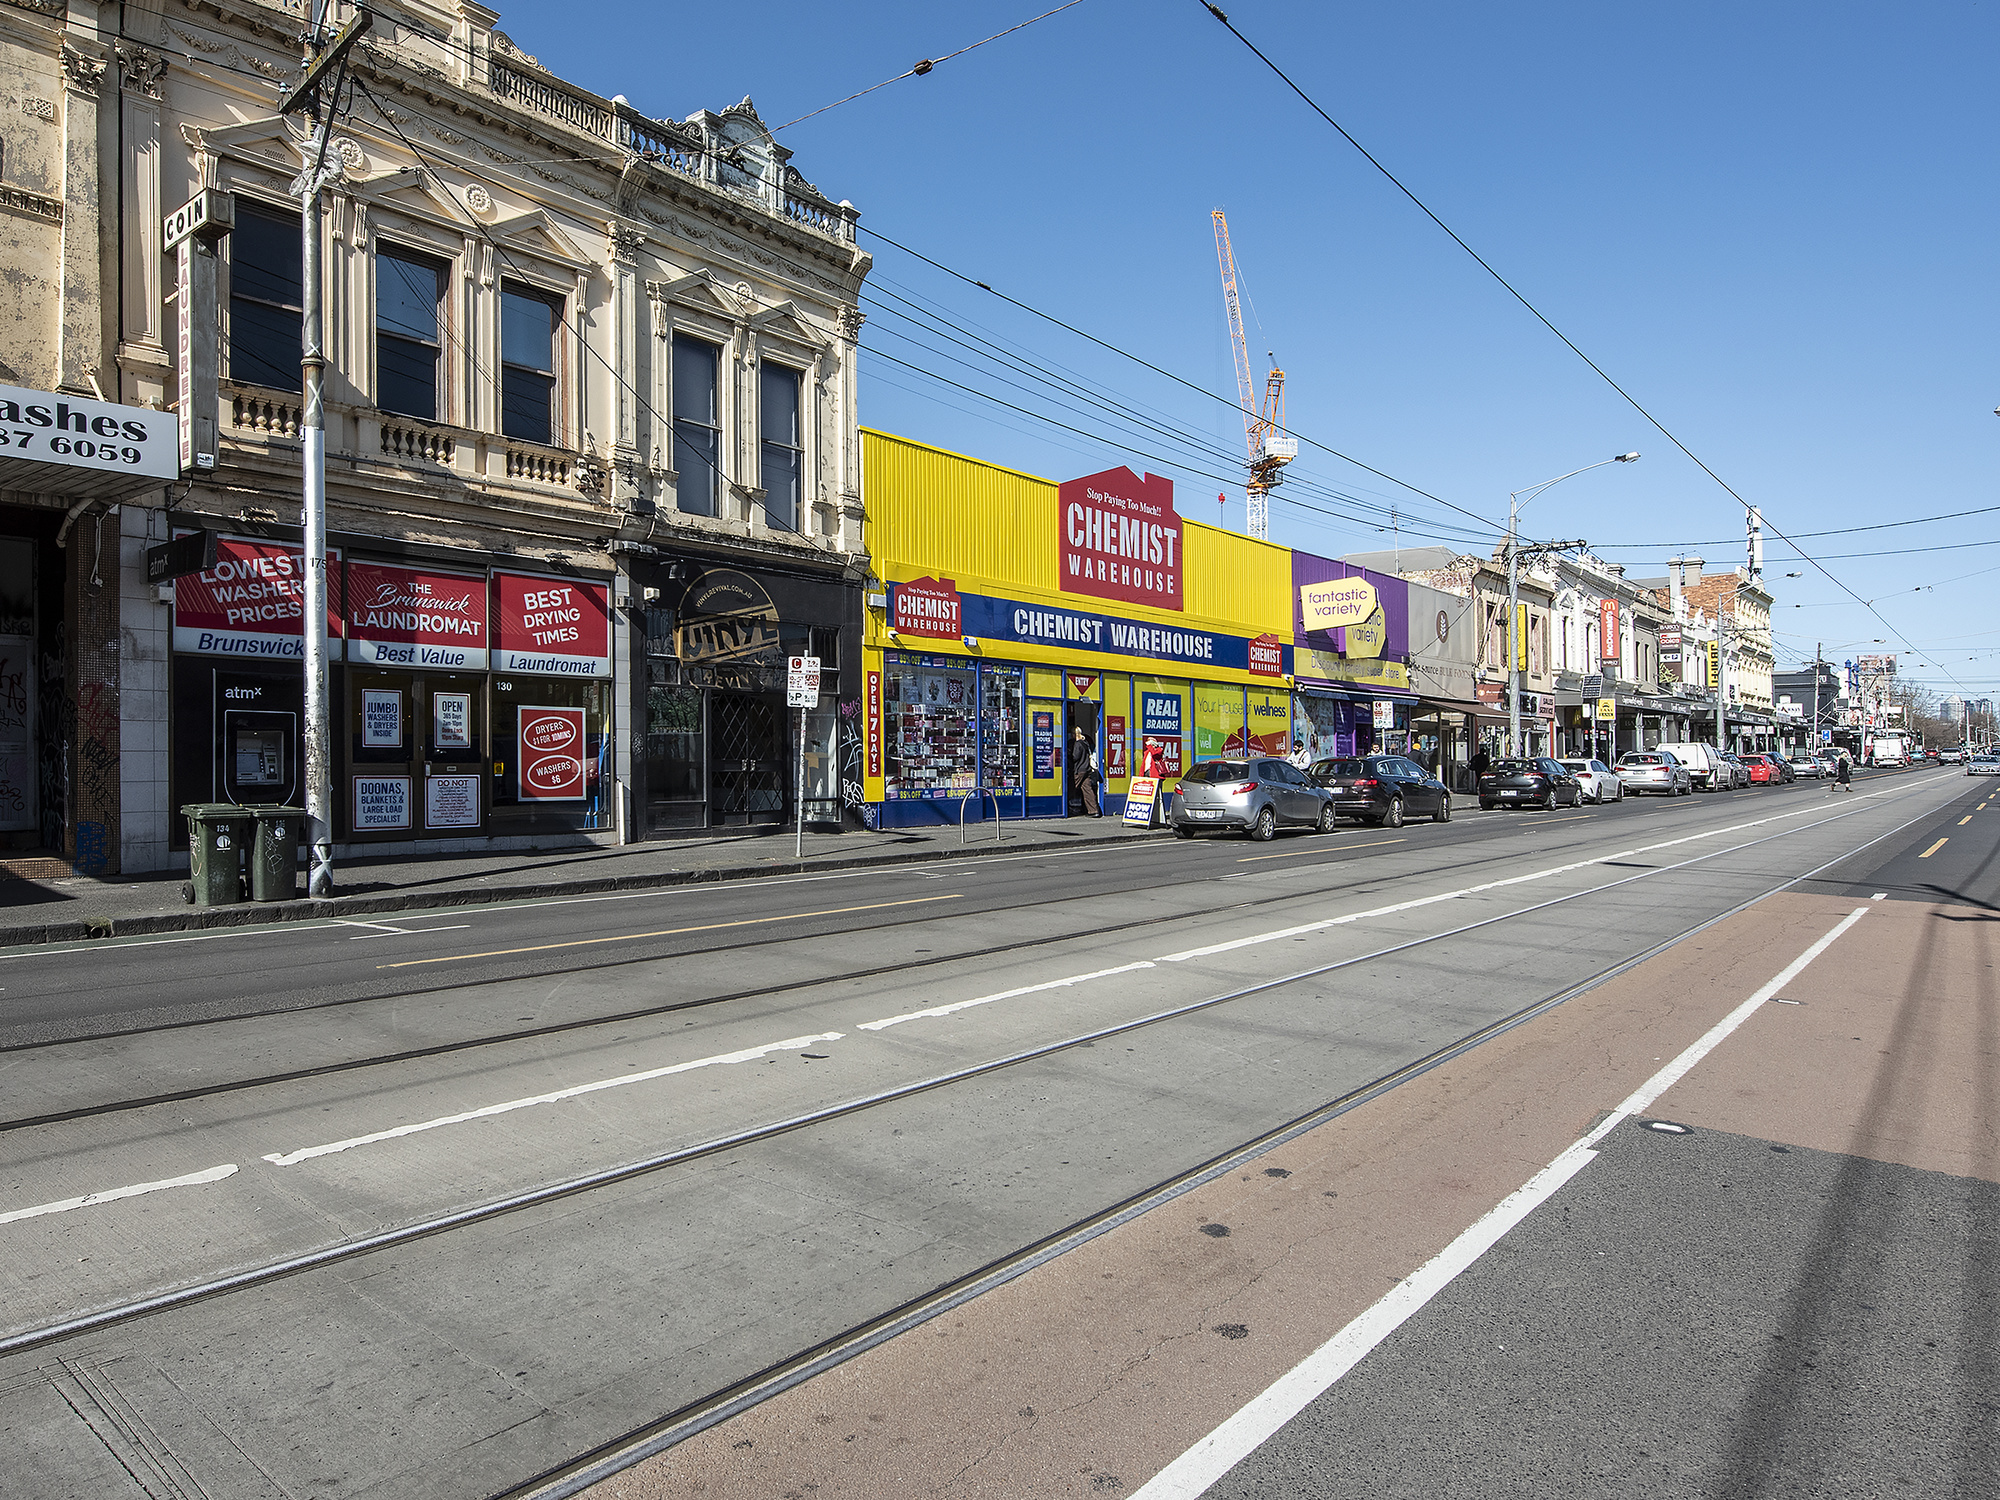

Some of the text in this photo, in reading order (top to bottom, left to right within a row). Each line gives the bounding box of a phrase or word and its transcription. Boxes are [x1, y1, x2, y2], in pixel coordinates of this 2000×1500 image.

[165, 197, 204, 241] COIN
[180, 247, 189, 460] LAUNDRETTE
[50, 436, 142, 464] 6059
[1086, 487, 1103, 503] Stop
[1103, 491, 1126, 510] Paying
[1126, 497, 1139, 511] Too
[1067, 502, 1178, 568] CHEMIST
[201, 553, 305, 584] LOWEST
[1068, 552, 1174, 595] WAREHOUSE
[407, 582, 432, 595] THE
[1308, 588, 1368, 604] fantastic
[365, 583, 470, 616] Brunswick
[523, 587, 572, 611] BEST
[897, 594, 959, 621] CHEMIST
[226, 600, 303, 625] PRICES
[1314, 602, 1362, 616] variety
[353, 611, 482, 637] LAUNDROMAT
[523, 607, 581, 629] DRYING
[897, 616, 957, 633] WAREHOUSE
[532, 626, 579, 646] TIMES
[1013, 608, 1213, 659] CHEMIST WAREHOUSE
[1351, 626, 1379, 647] variety
[197, 632, 305, 656] Brunswick
[375, 645, 465, 666] Best Value
[1250, 646, 1280, 664] CHEMIST
[509, 654, 596, 674] Laundromat
[1385, 668, 1400, 680] store
[496, 682, 512, 692] 130
[366, 702, 398, 713] JUMBO
[441, 700, 463, 712] OPEN
[1146, 698, 1179, 717] REAL
[1197, 696, 1216, 713] Your
[1218, 698, 1244, 714] House
[366, 713, 398, 721] WASHERS
[373, 721, 398, 730] DRYERS
[869, 674, 879, 773] OPEN 7 DAYS
[1145, 719, 1179, 730] BRANDS!
[372, 729, 392, 737] INSIDE
[535, 721, 564, 735] DRYERS
[1108, 733, 1125, 742] OPEN
[1111, 743, 1122, 765] 7
[536, 760, 571, 777] WASHERS
[1109, 766, 1125, 775] DAYS
[437, 779, 469, 787] DO NOT
[551, 774, 561, 784] $6
[361, 782, 405, 796] DOONAS,
[361, 795, 397, 805] BLANKETS
[1128, 802, 1151, 812] NOW
[362, 804, 403, 814] LARGE LOAD
[1126, 810, 1150, 820] OPEN
[364, 815, 401, 824] SPECIALIST
